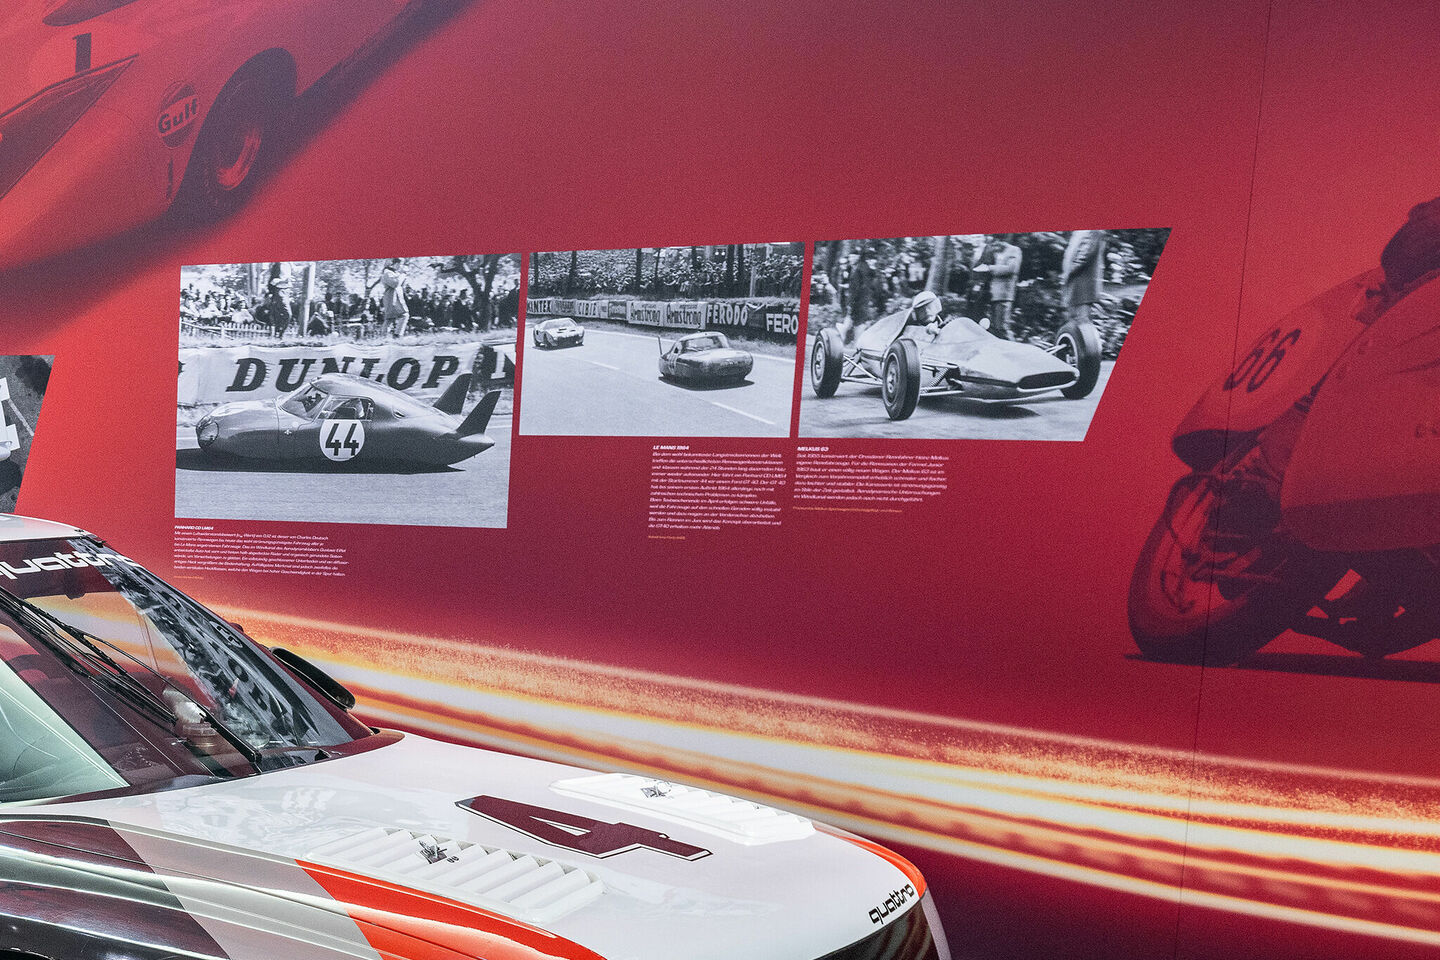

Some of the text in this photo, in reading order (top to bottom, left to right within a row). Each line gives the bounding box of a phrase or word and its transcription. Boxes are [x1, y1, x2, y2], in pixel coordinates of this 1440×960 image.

[158, 98, 198, 133] Gulf
[666, 302, 701, 328] Armstrong
[707, 303, 748, 326] FERODO
[225, 355, 460, 392] DUNLOP
[325, 422, 360, 457] 44
[454, 794, 714, 862] 4
[868, 882, 916, 925] quattro
